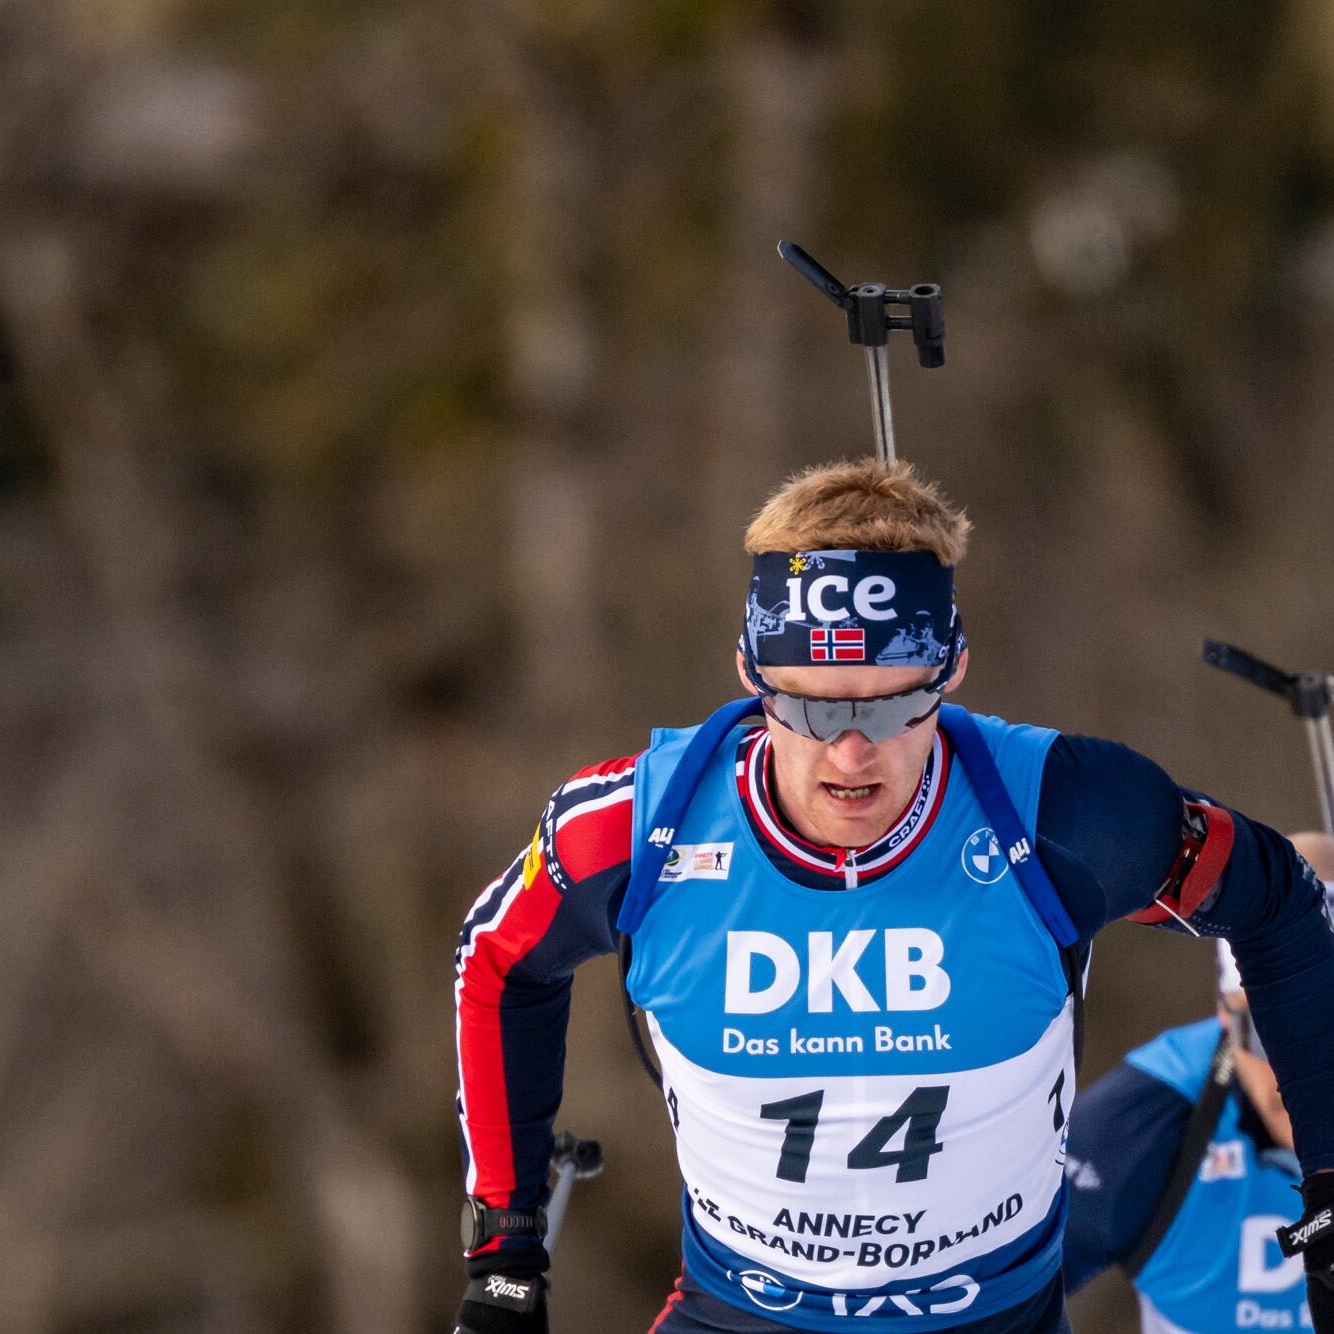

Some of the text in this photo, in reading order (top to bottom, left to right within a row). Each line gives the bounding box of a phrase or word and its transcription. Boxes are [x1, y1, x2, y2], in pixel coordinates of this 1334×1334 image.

[785, 575, 898, 621] ice
[888, 791, 926, 848] CRAFT
[723, 927, 952, 1015] DKB
[722, 1024, 952, 1056] Das kann Bank
[760, 1085, 951, 1184] 14
[772, 1207, 928, 1239] ANNECY
